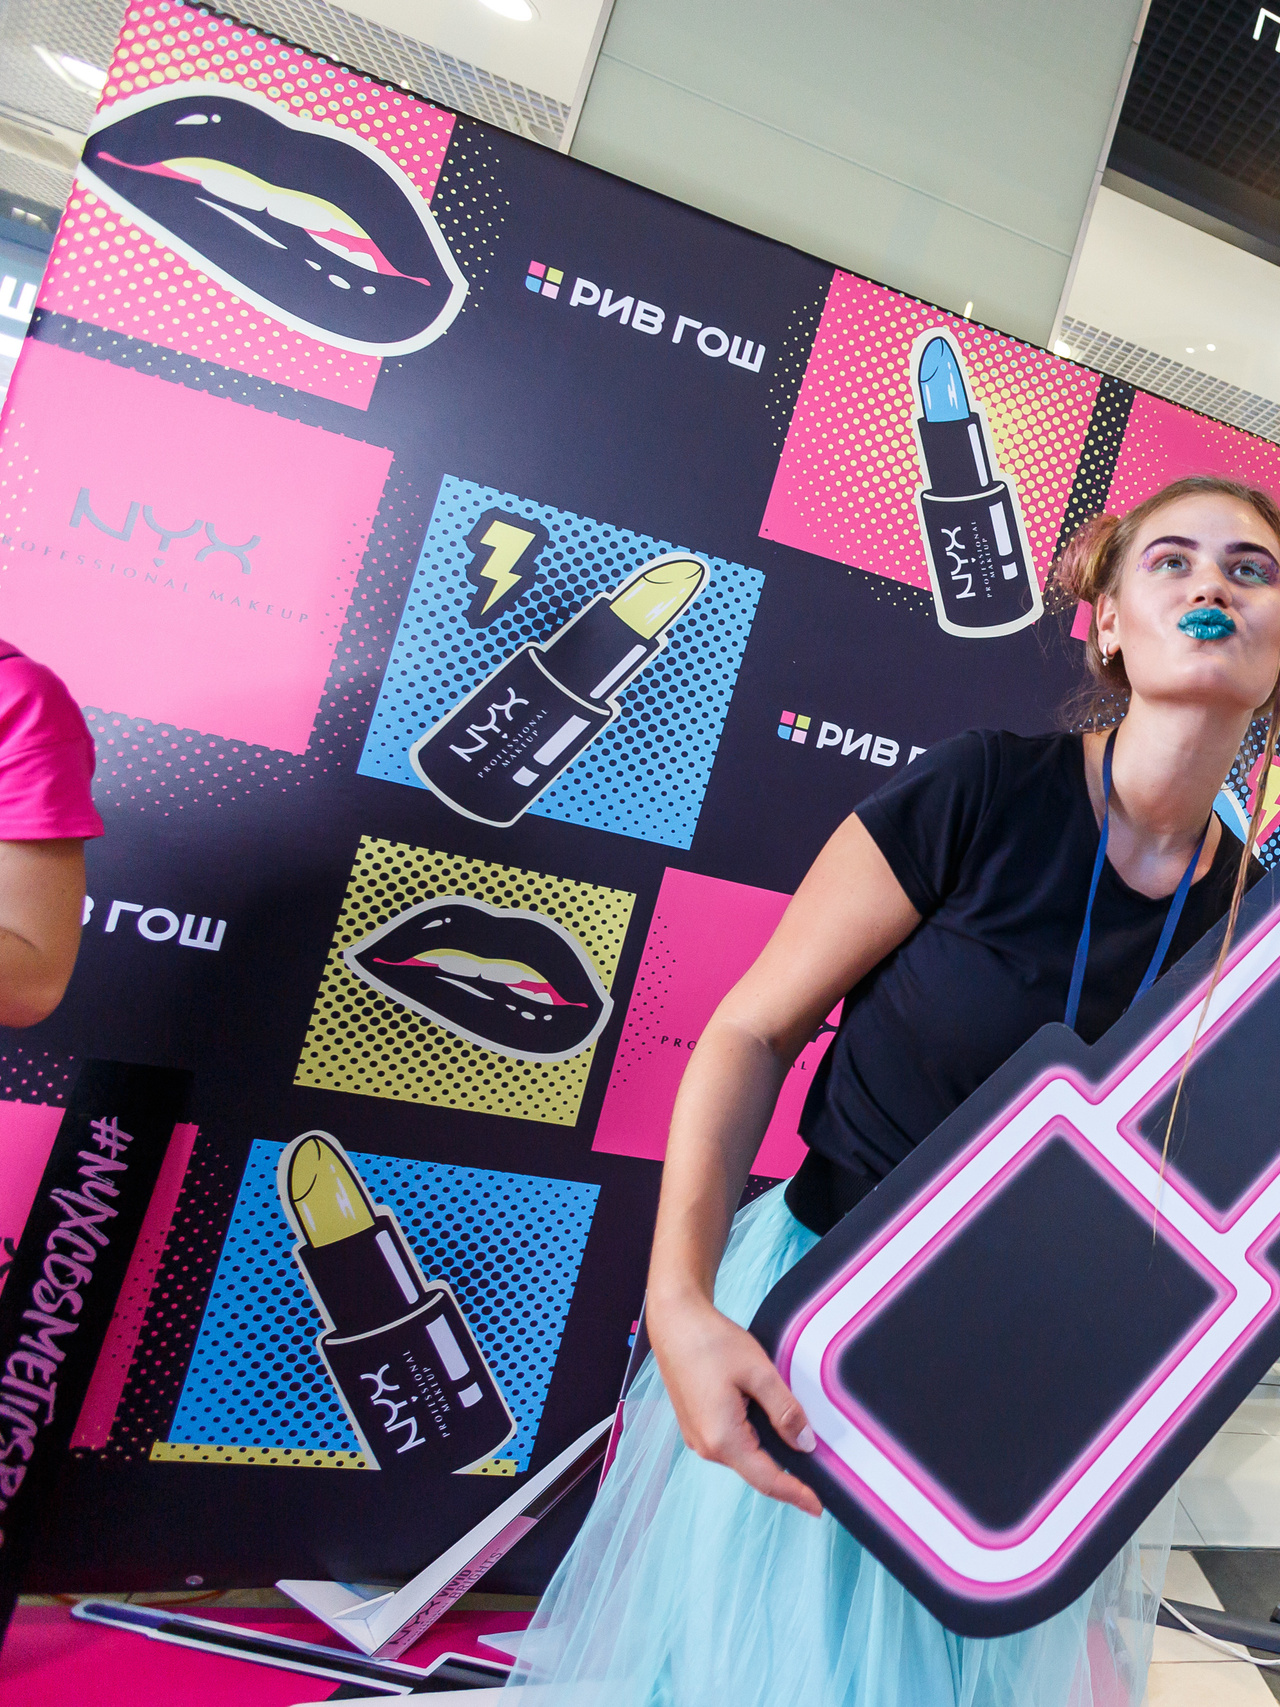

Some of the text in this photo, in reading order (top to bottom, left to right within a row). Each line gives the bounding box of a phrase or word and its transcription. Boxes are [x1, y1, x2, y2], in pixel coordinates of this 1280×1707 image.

[571, 277, 765, 373] РИВ ГОШ
[69, 487, 261, 575] NYX
[940, 526, 976, 599] NYX
[1, 534, 309, 623] ROFESSIONAL MAKEUP
[449, 687, 529, 763] NYX
[816, 721, 900, 767] РИВ
[106, 902, 227, 953] ГОШ
[360, 1363, 427, 1454] NYX
[437, 1569, 472, 1598] VIVID
